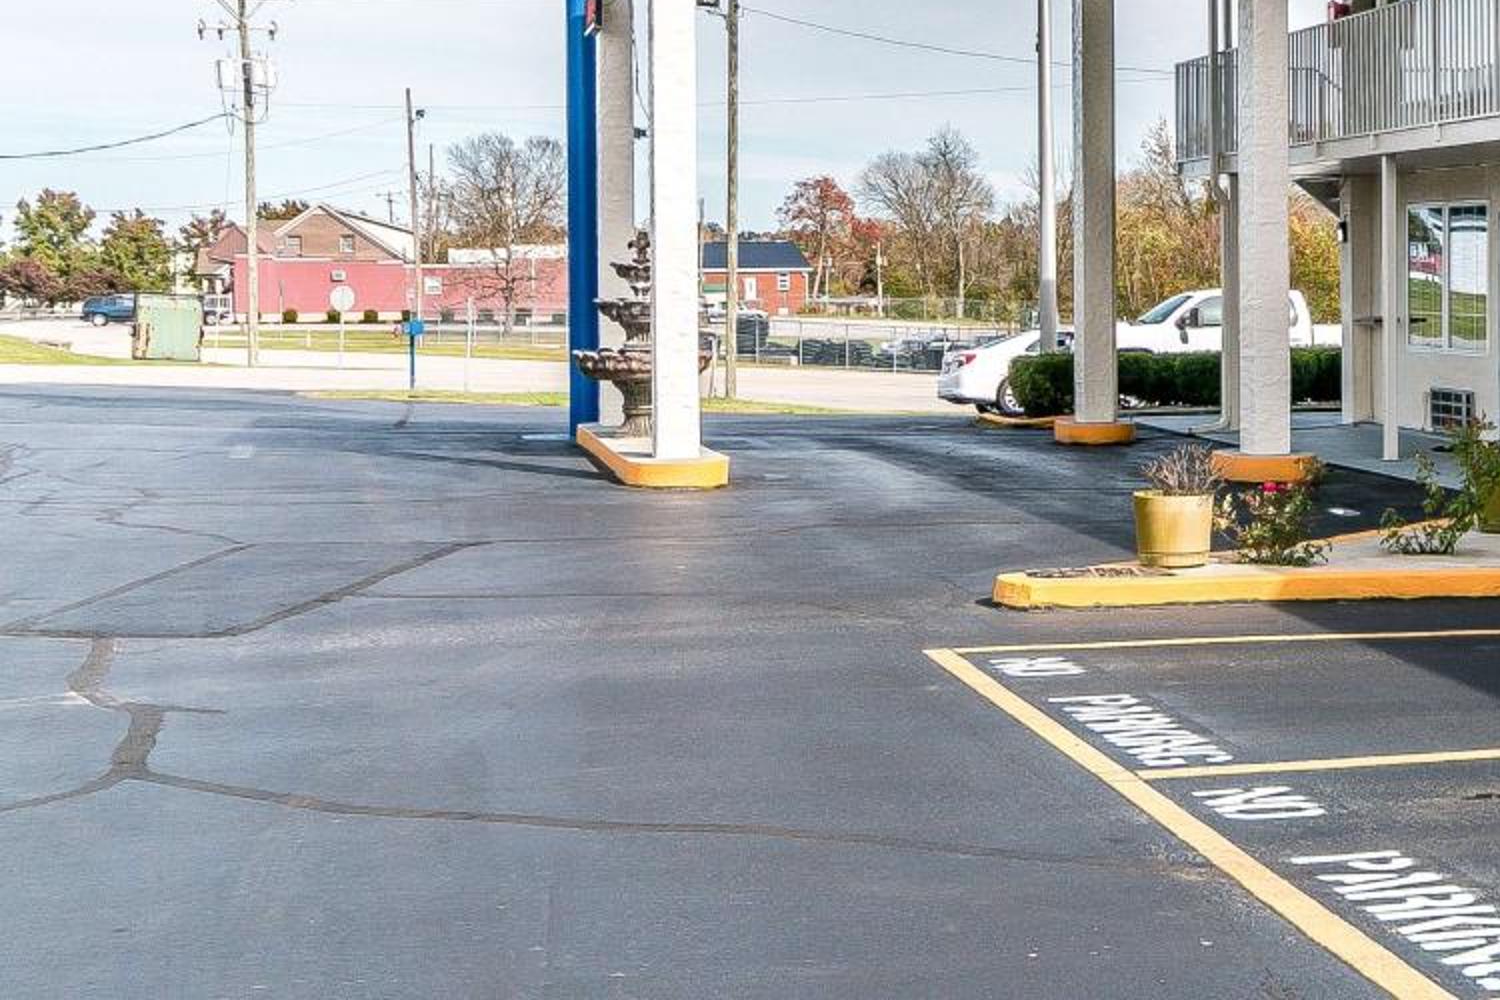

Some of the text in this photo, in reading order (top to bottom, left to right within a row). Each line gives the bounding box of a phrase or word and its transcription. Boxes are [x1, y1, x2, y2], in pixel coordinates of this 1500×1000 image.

[989, 656, 1087, 678] NO
[1047, 693, 1234, 768] PARKING
[1191, 785, 1326, 821] NO
